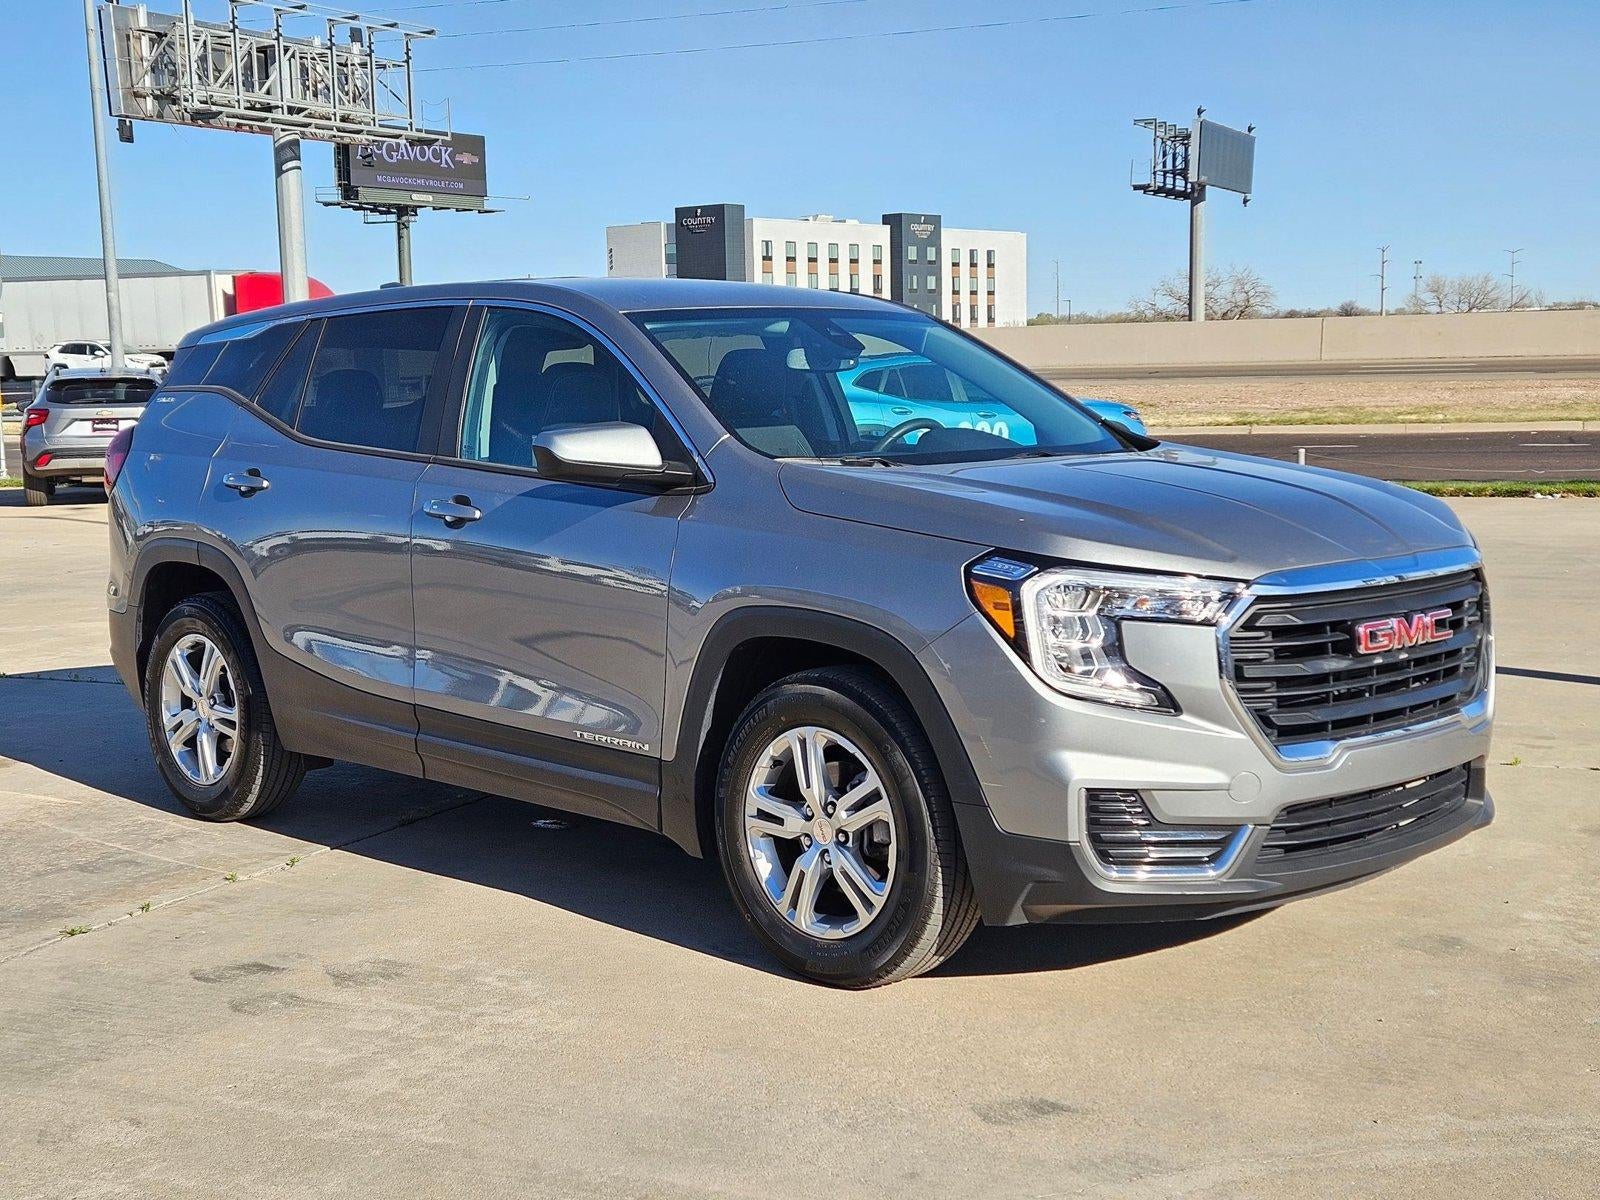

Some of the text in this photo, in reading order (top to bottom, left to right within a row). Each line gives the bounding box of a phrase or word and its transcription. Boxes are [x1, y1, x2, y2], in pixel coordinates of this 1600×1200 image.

[376, 174, 464, 189] MCGAVOCKCHEVROLET.COM
[682, 216, 716, 226] COUNTRY
[1355, 608, 1454, 655] GMC
[572, 730, 650, 752] TERRAIN
